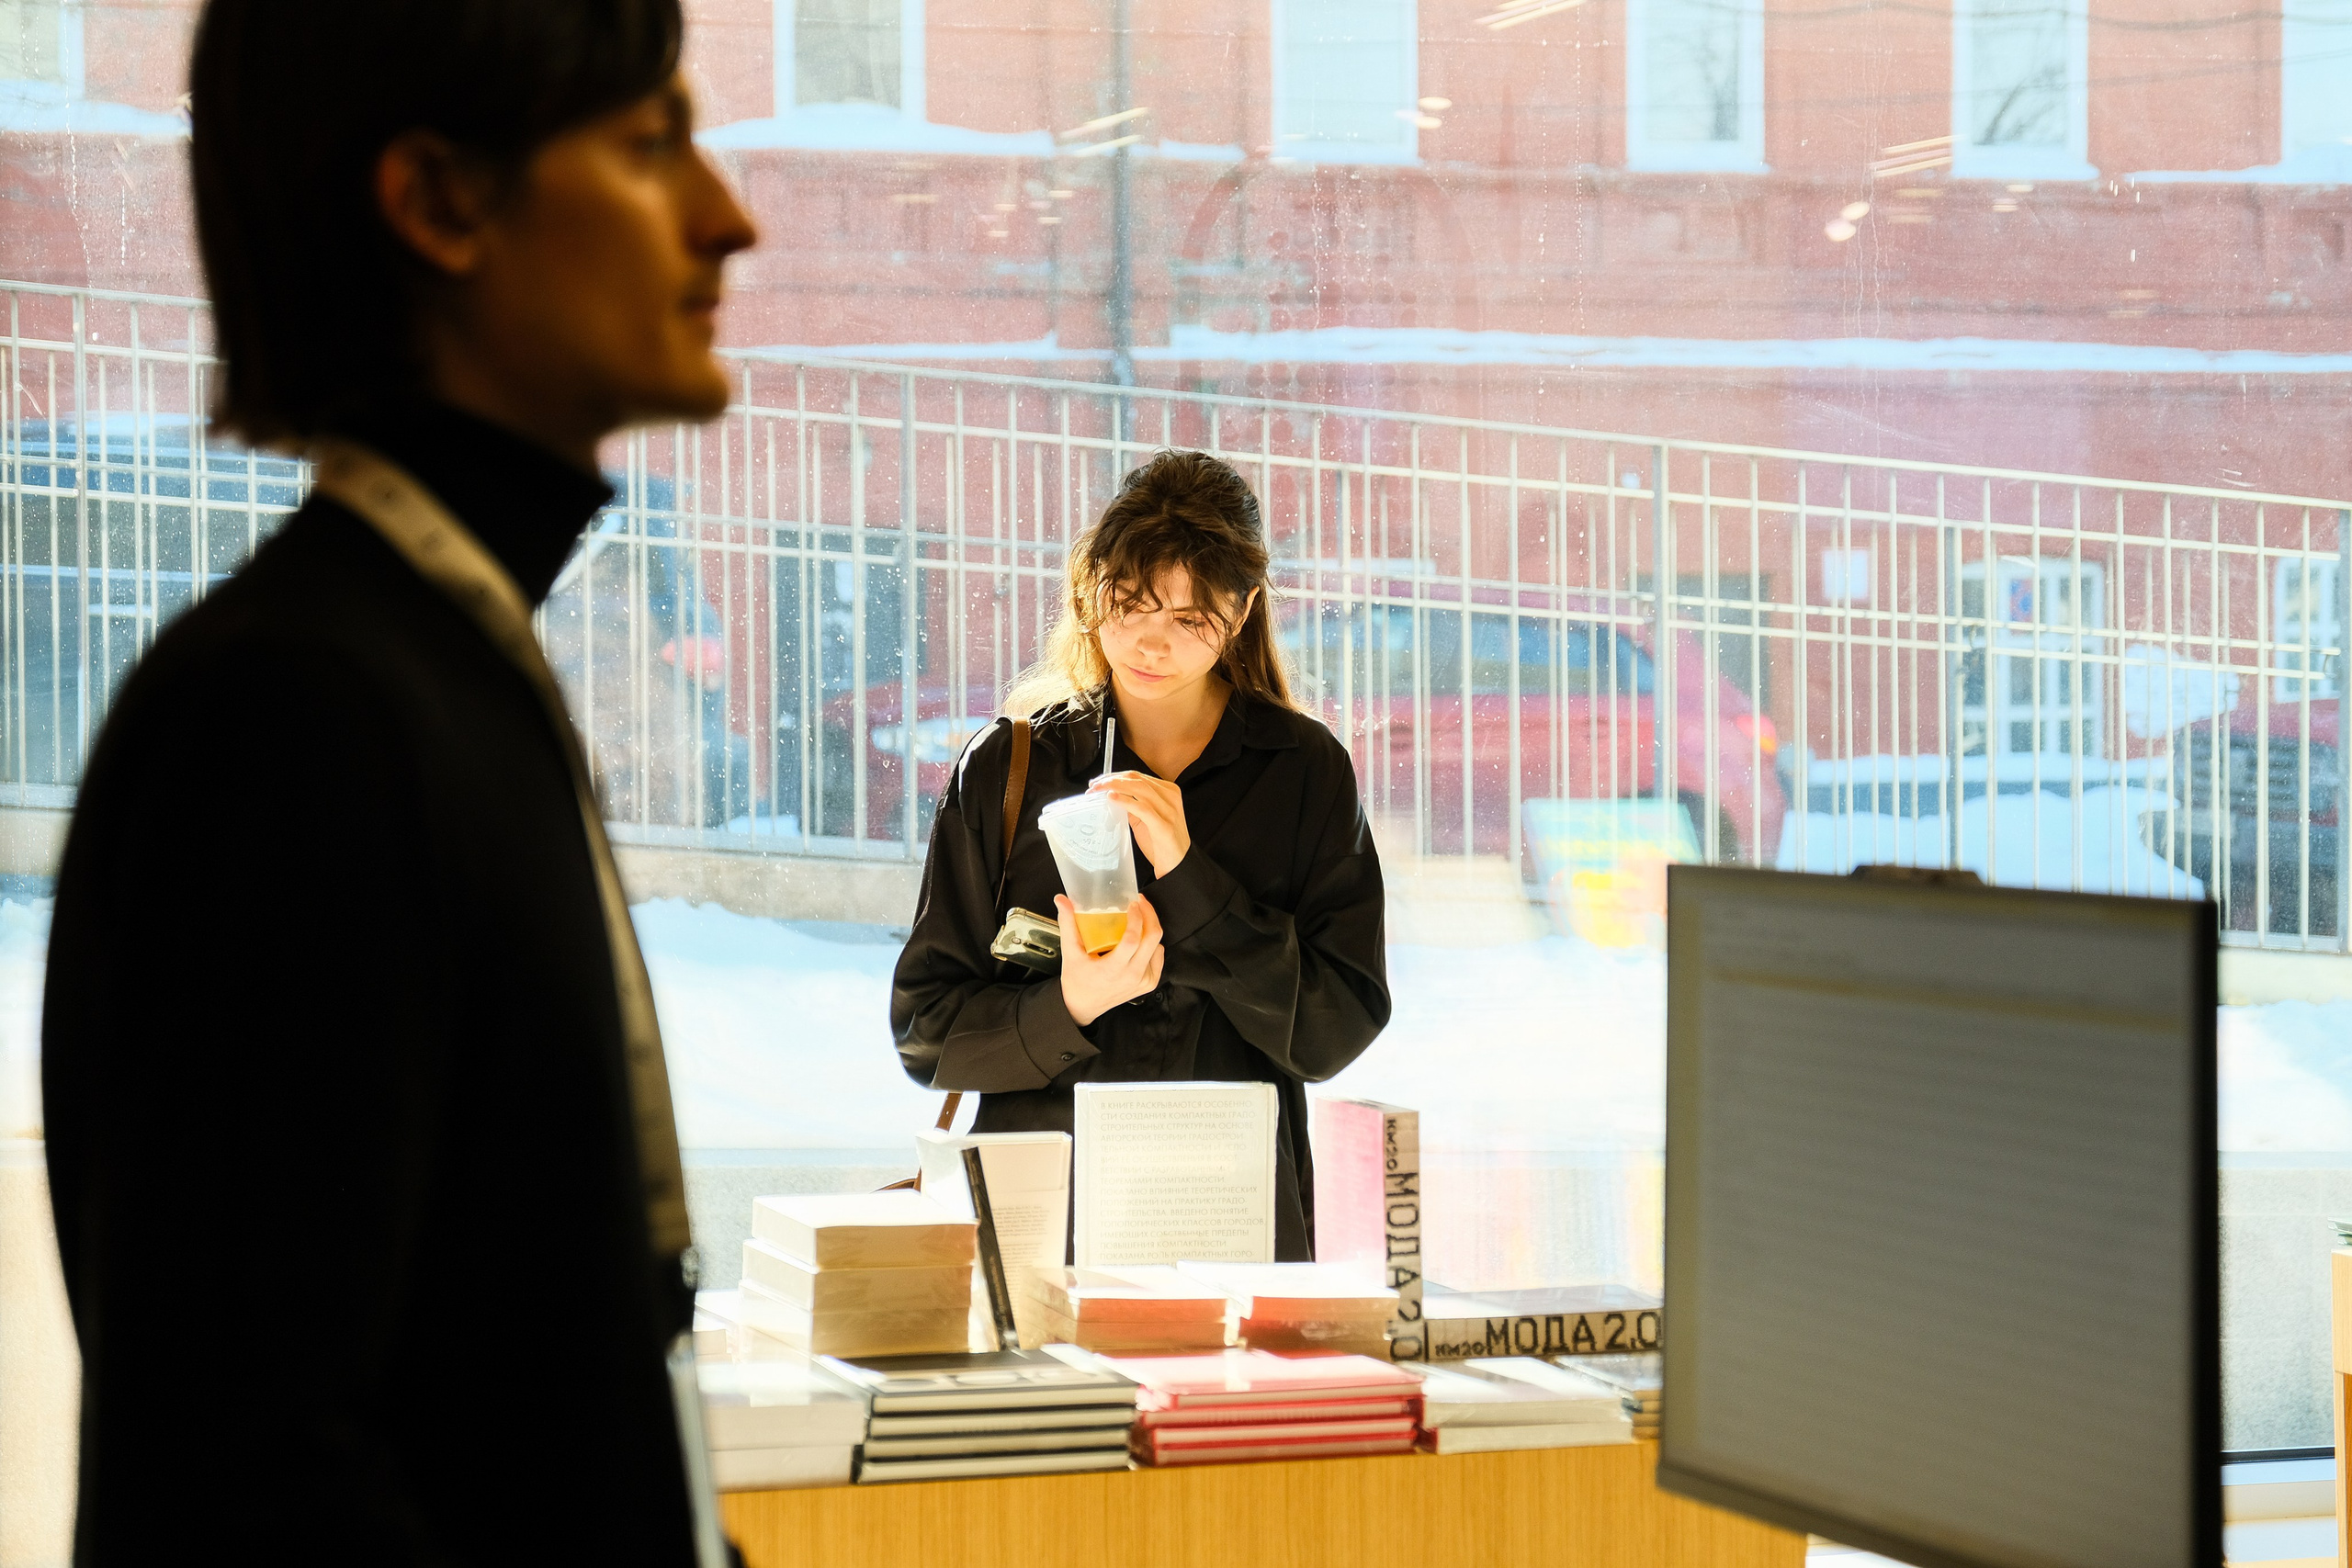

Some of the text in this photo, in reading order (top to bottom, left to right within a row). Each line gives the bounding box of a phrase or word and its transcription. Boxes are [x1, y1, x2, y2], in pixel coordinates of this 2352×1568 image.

[1108, 1101, 1134, 1110] КНИГЕ
[1136, 1100, 1202, 1110] РАСКРЫВАЮТСЯ
[1101, 1112, 1117, 1121] СТИ
[1119, 1112, 1167, 1121] СОЗДАНИЯ
[1168, 1111, 1227, 1120] КОМПАКТНЫХ
[1101, 1123, 1165, 1132] СТРОИТЕЛЬНЫХ
[1166, 1122, 1204, 1131] СТРУКТУР
[1218, 1122, 1255, 1130] ОСНОВЕ
[1101, 1133, 1151, 1142] АВТОРСКОЙ
[1153, 1134, 1186, 1142] ТЕОРИИ
[1141, 1144, 1212, 1152] КОМПАКТНОСТИ
[1143, 1166, 1149, 1174] С
[1101, 1177, 1152, 1185] ТЕОРЕМАМИ
[1101, 1186, 1258, 1196] ПОКАЗАНО ВЛИЯНИЕ ТЕОРЕТИЧЕСКИХ
[1100, 1197, 1159, 1206] ПОЛОЖЕНИЙ
[1174, 1197, 1216, 1205] ПРАКТИКУ
[1170, 1208, 1208, 1216] ВВЕДЕНО
[1210, 1207, 1250, 1215] ПОНЯТИЕ
[1101, 1220, 1180, 1228] ТОПОЛОГИЧЕСКИХ
[1100, 1229, 1250, 1239] ИМЕЮЩИХ СОБСТВЕННЫЕ ПРЕДЕЛЫ
[1385, 1172, 1420, 1288] МОДА
[1100, 1241, 1155, 1250] ПОВЫШЕНИЯ
[1100, 1252, 1146, 1260] ПОКАЗАНА
[1147, 1251, 1169, 1259] РОЛЬ
[1170, 1250, 1228, 1259] КОМПАКТНЫХ
[1486, 1315, 1596, 1356] МОДА
[1604, 1311, 1660, 1351] 2.0
